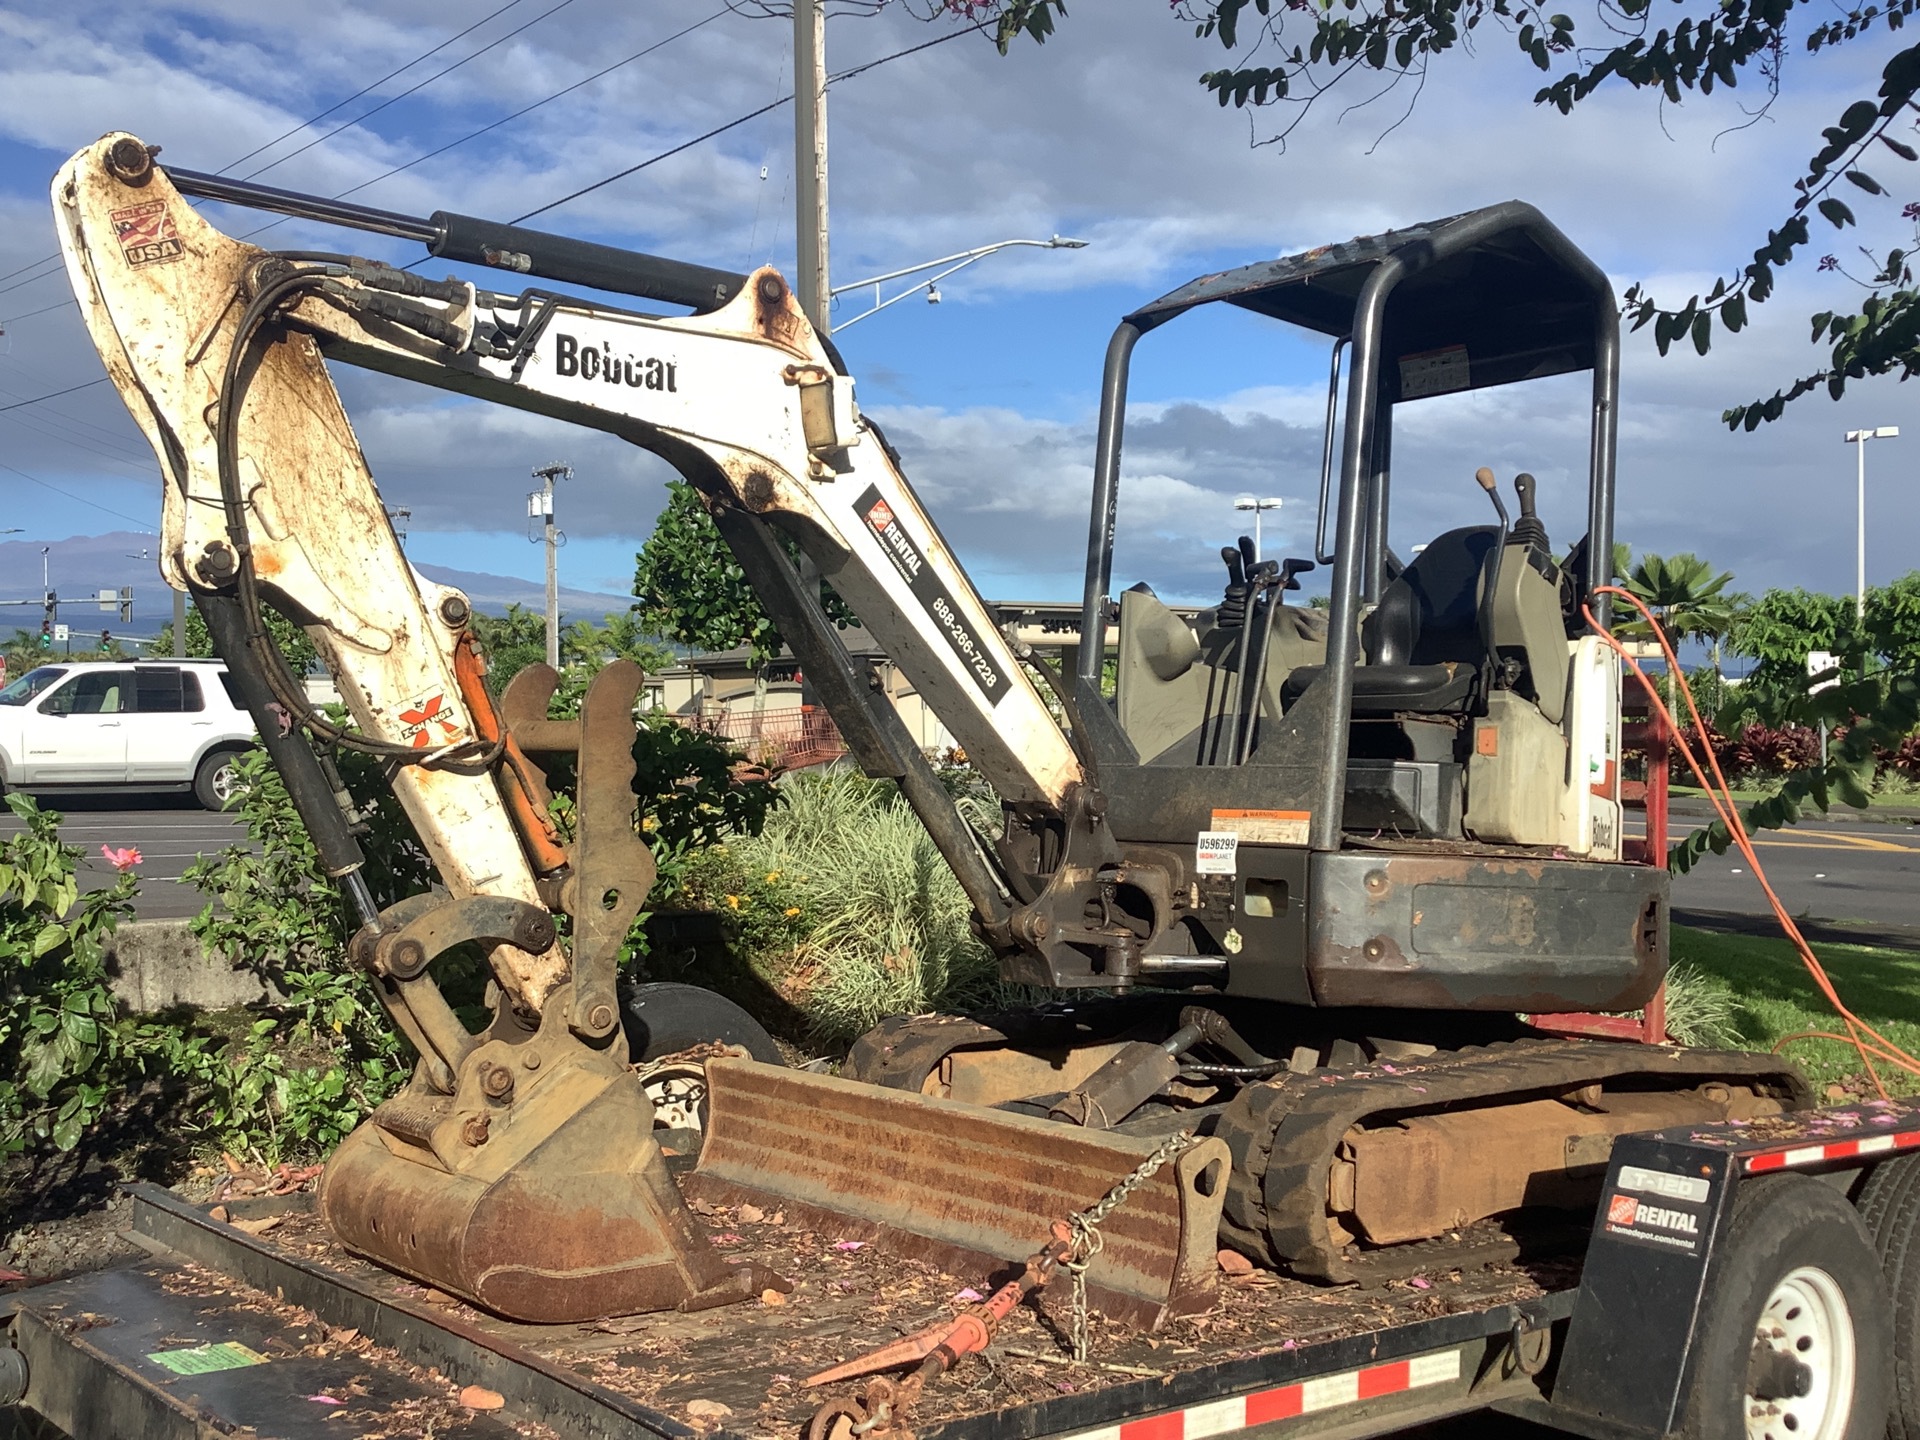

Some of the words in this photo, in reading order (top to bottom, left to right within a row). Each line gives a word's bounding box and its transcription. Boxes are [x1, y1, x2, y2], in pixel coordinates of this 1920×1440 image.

[127, 241, 180, 264] USA
[555, 332, 678, 394] Bobcat
[883, 520, 922, 577] RENTAL
[1041, 618, 1082, 634] SAFEW
[932, 597, 998, 688] 888-266-7228
[401, 706, 454, 740] X-CHANGE
[1199, 838, 1236, 850] U596299
[1634, 1172, 1694, 1196] T-120
[1634, 1203, 1699, 1234] RENTAL
[1611, 1224, 1696, 1250] homedepot.com/rental
